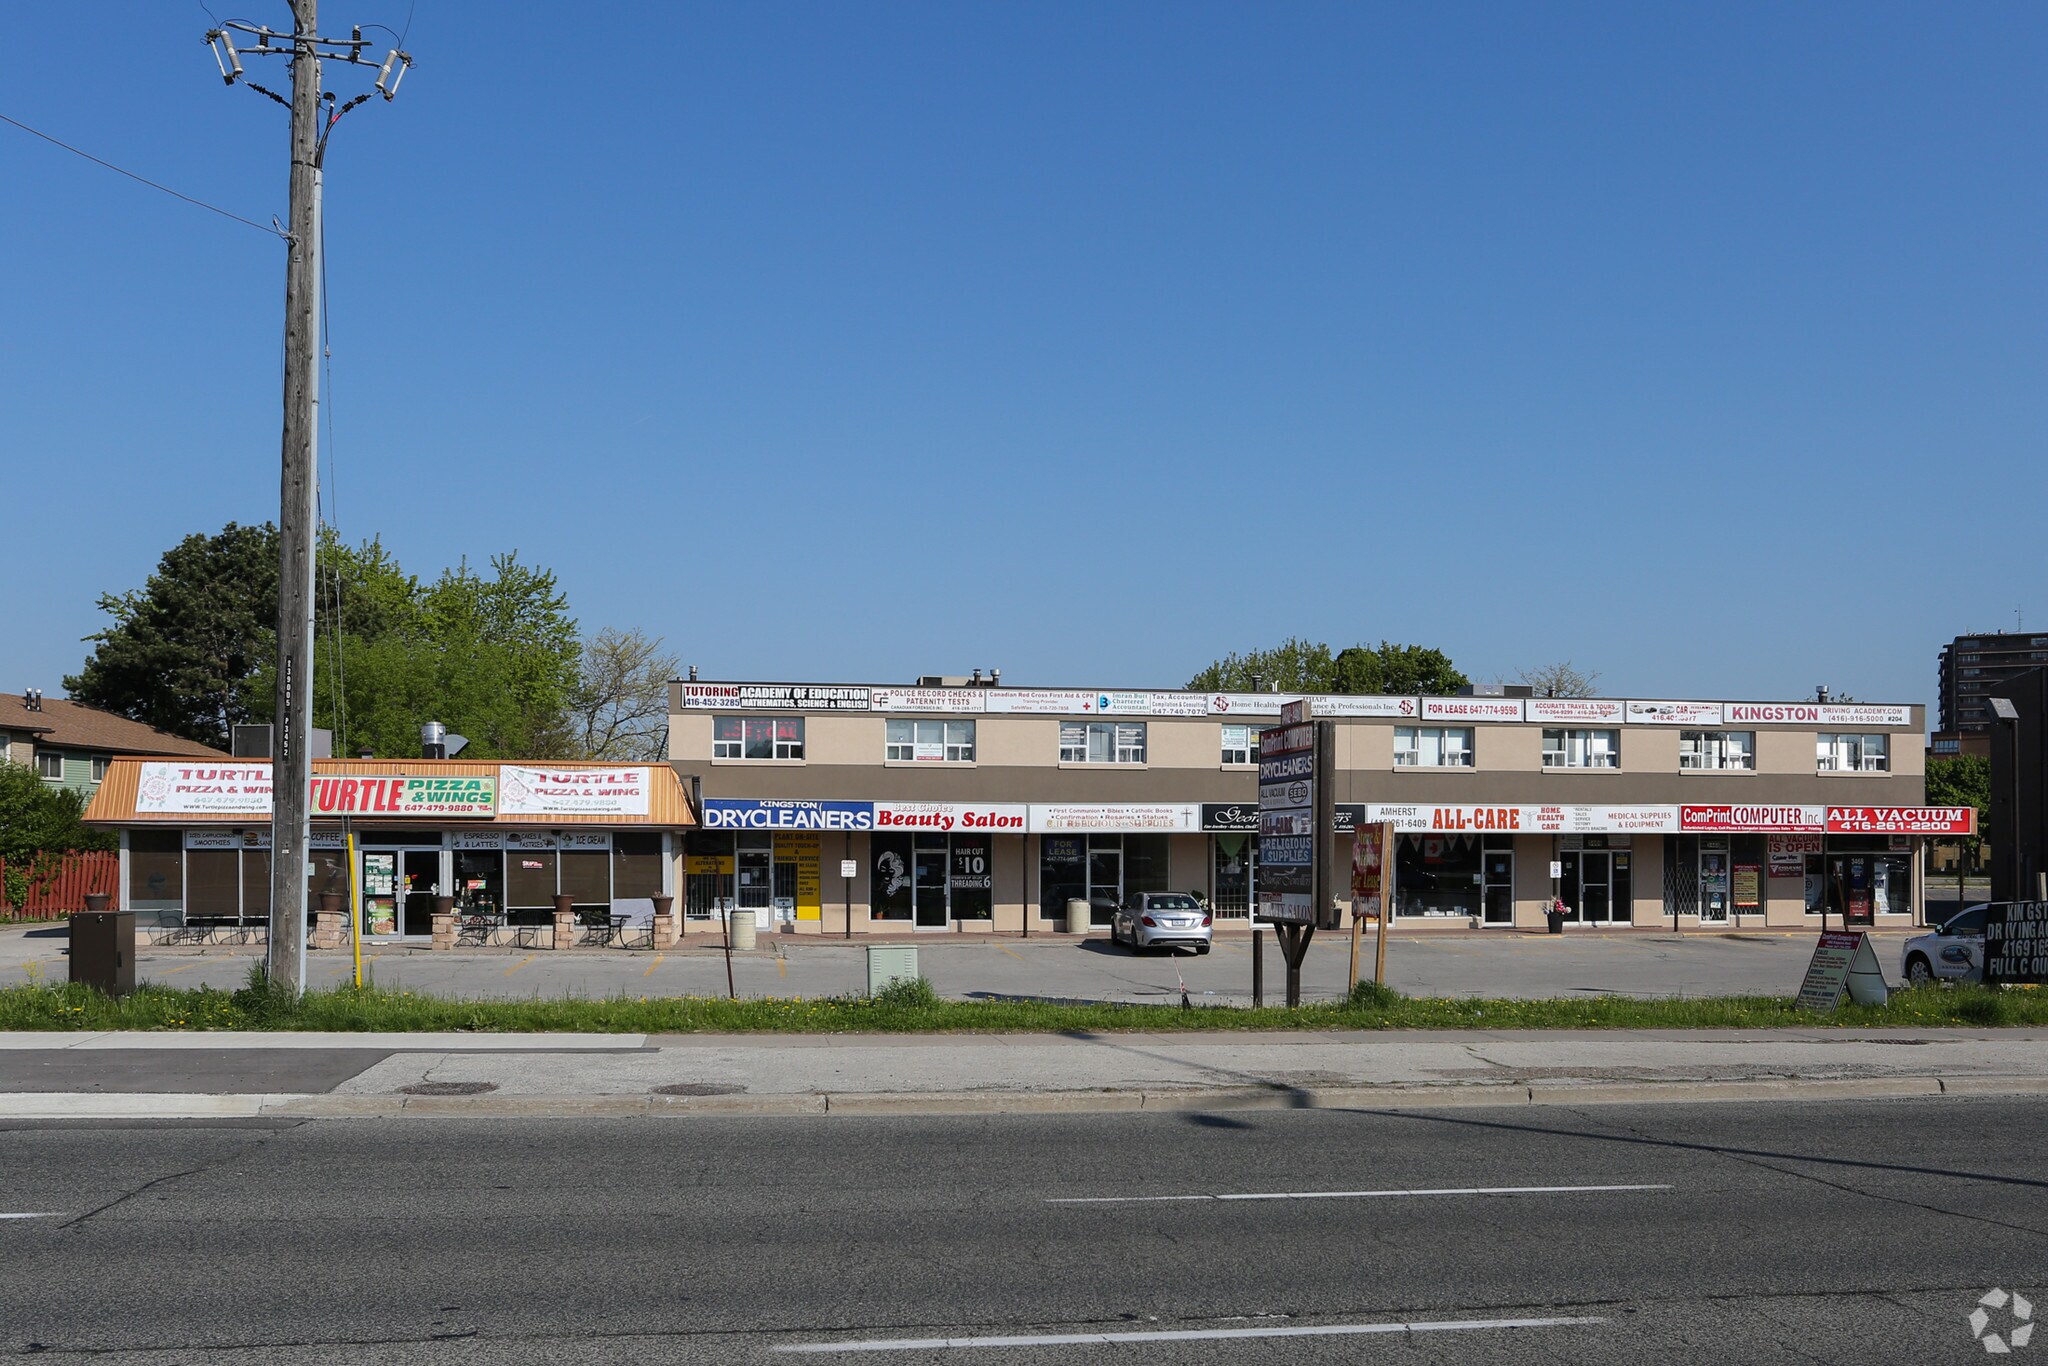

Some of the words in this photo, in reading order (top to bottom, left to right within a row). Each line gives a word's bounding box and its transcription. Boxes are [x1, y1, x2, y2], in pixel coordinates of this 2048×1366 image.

[685, 686, 739, 696] TUTORING
[740, 688, 791, 699] ACADEMY
[794, 689, 807, 699] OF
[808, 689, 868, 700] EDUCATION
[918, 690, 946, 698] RECORD
[1168, 694, 1206, 702] Accounting
[686, 698, 740, 707] 416-452-3285
[741, 699, 797, 708] MATHEMATICS,
[798, 700, 829, 708] SCIENCE
[830, 700, 836, 708] &
[837, 700, 867, 709] ENGLISH
[1152, 708, 1206, 716] 647-740-7070
[1428, 704, 1443, 714] FOR
[1445, 704, 1468, 714] LEASE
[1470, 706, 1518, 716] 647-774-9598
[1676, 706, 1688, 714] CAR
[1732, 707, 1818, 721] KINGSTON
[1284, 726, 1313, 750] COMPUTER
[1260, 756, 1312, 780] DRYCLEANERS
[178, 770, 273, 781] TURTL
[535, 773, 640, 784] TURTLE
[176, 786, 223, 794] PIZZA
[227, 786, 238, 794] &
[408, 780, 481, 791] PIZZA
[311, 779, 405, 811] TURTLE
[534, 788, 579, 796] PIZZA
[583, 788, 593, 796] &
[598, 788, 640, 797] WING
[1290, 788, 1307, 798] SEBO
[404, 804, 473, 812] 647-479-9880
[760, 800, 818, 809] KINGSTON
[893, 804, 917, 812] Best
[918, 804, 954, 812] Choice
[1380, 808, 1417, 816] AMHERST
[1684, 808, 1731, 823] ComPrint
[1734, 808, 1802, 824] COMPUTER
[1805, 811, 1821, 825] Inc.
[1828, 809, 1868, 821] ALL
[1874, 810, 1963, 821] VACUUM
[706, 809, 871, 829] DRYCLEANERS
[878, 811, 955, 831] Beauty
[962, 812, 1023, 828] Salon
[1432, 808, 1520, 829] ALL-CARE
[1841, 822, 1951, 830] 416-261-2200
[311, 832, 340, 840] COFFEE
[576, 836, 584, 844] ICE
[586, 836, 606, 845] CREAM
[1769, 835, 1784, 843] ALL
[1787, 834, 1820, 843] VACUUM
[1054, 840, 1072, 848] FOR
[1266, 838, 1312, 850] RELIGIOUS
[1768, 844, 1780, 853] IS
[1786, 843, 1820, 853] OPEN
[1050, 848, 1077, 856] LEASE
[1268, 850, 1309, 862] SUPPLIES
[951, 880, 983, 888] THREADING
[1987, 922, 2036, 940] DRIVING
[1990, 959, 2017, 976] FULL
